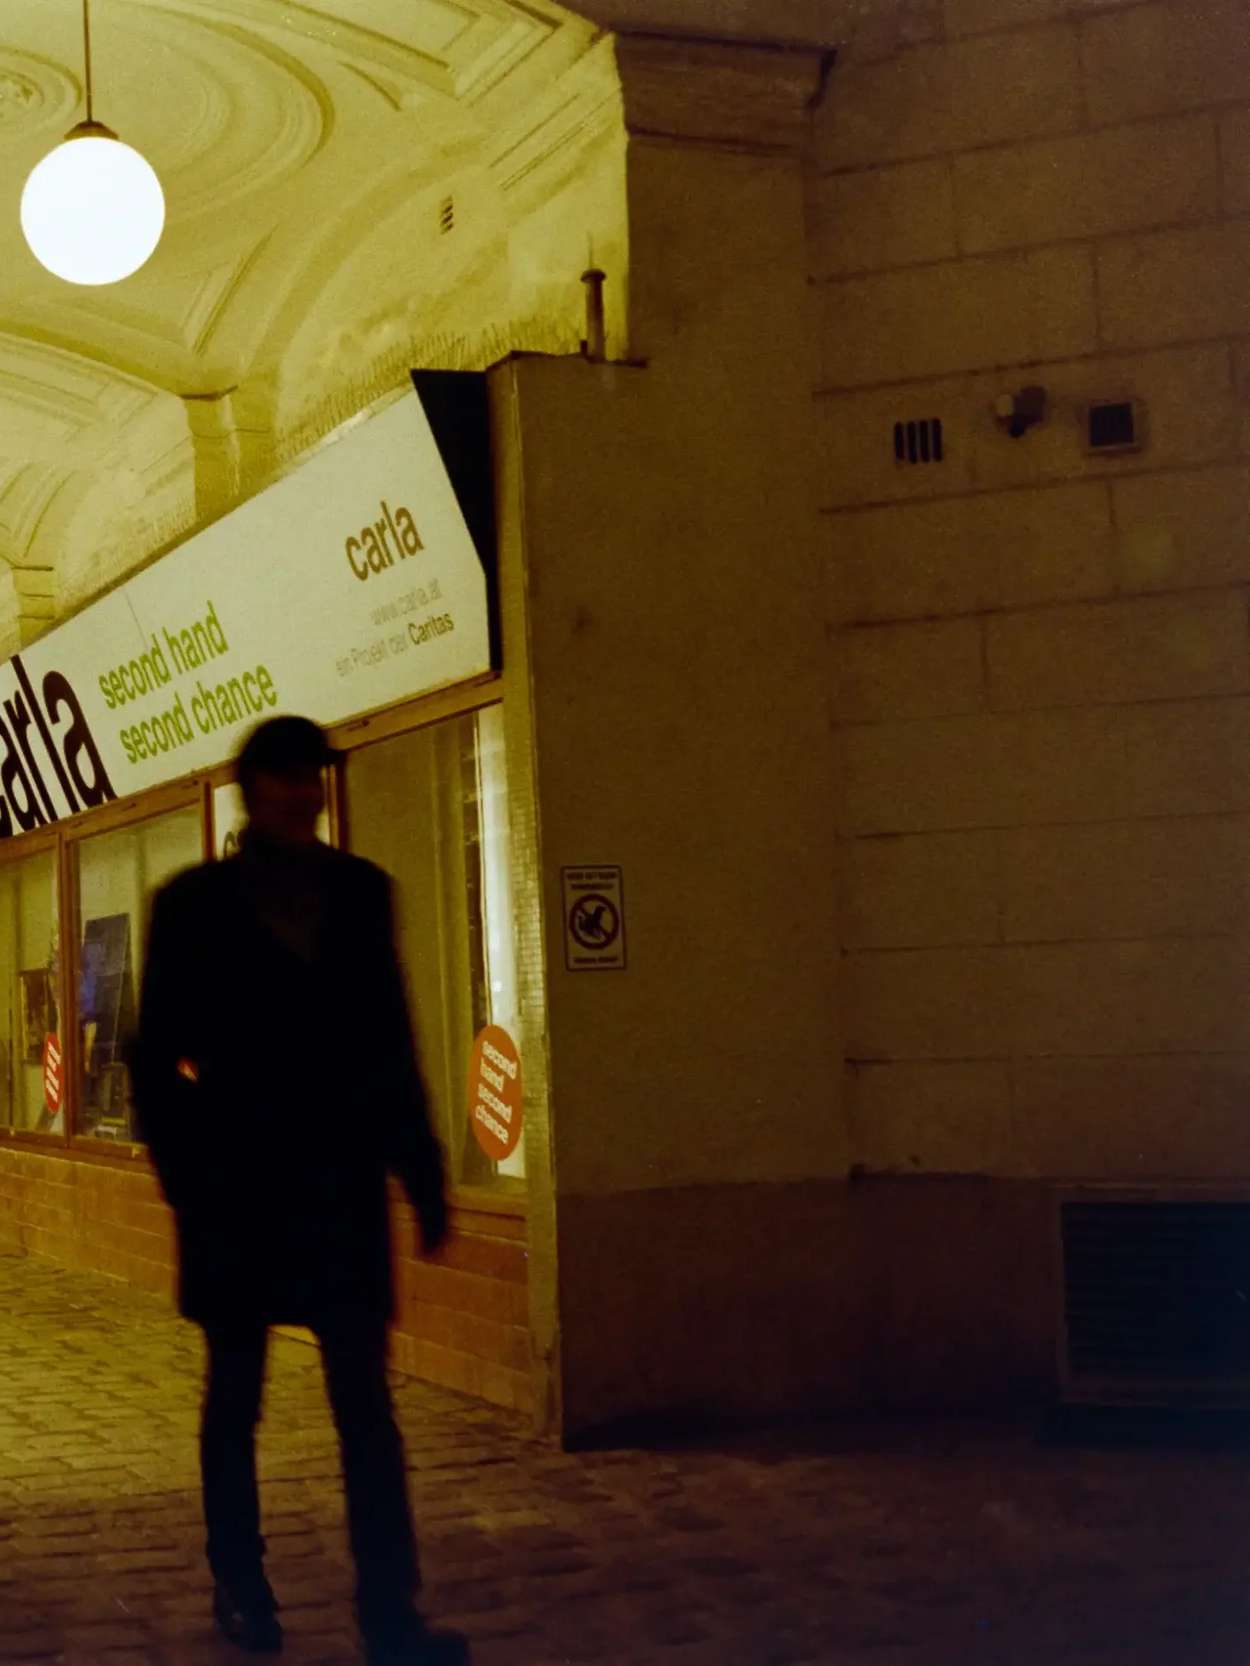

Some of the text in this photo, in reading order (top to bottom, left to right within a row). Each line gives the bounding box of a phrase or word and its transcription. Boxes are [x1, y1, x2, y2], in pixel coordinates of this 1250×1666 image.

[345, 500, 425, 581] carla
[99, 600, 229, 710] second hand
[407, 612, 454, 645] Caritas
[119, 665, 278, 764] second chance
